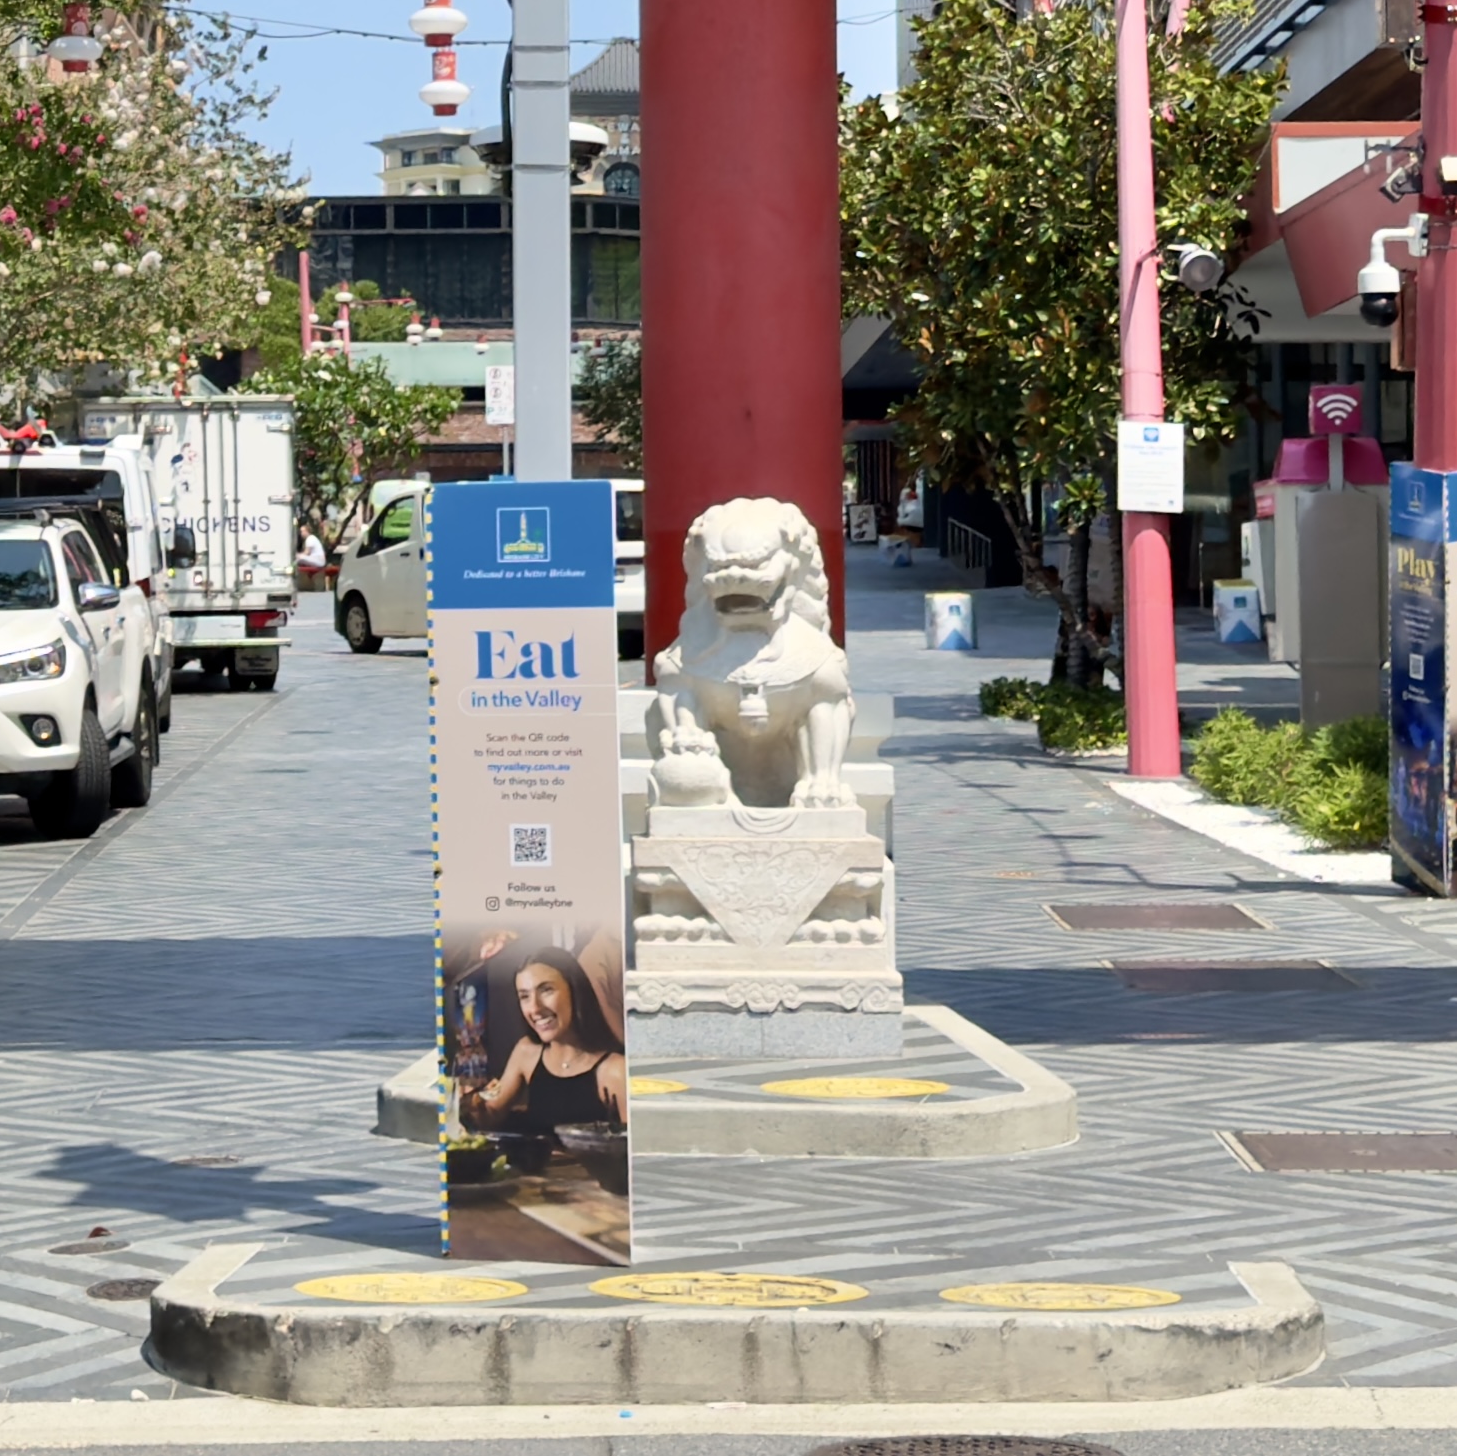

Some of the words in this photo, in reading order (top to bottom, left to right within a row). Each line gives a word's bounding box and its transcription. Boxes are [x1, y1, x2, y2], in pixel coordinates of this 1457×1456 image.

[1396, 546, 1436, 586] Play
[473, 628, 580, 679] Eat
[471, 691, 488, 707] in
[492, 690, 522, 707] the
[525, 690, 582, 711] Valley
[486, 733, 509, 742] Scan
[511, 733, 526, 742] the
[529, 733, 543, 742] QR
[546, 733, 570, 742] code
[474, 749, 483, 757] to
[486, 747, 504, 757] find
[507, 748, 522, 757] out
[565, 747, 583, 756] visit
[487, 763, 571, 773] myvalley.com.au
[493, 776, 506, 786] for
[509, 776, 537, 788] things
[539, 777, 550, 786] to
[552, 776, 565, 786] do
[501, 792, 510, 800] in
[513, 791, 528, 800] the
[530, 791, 557, 802] Valley
[507, 882, 541, 892] Follow
[505, 898, 573, 909] @myvalleybne
